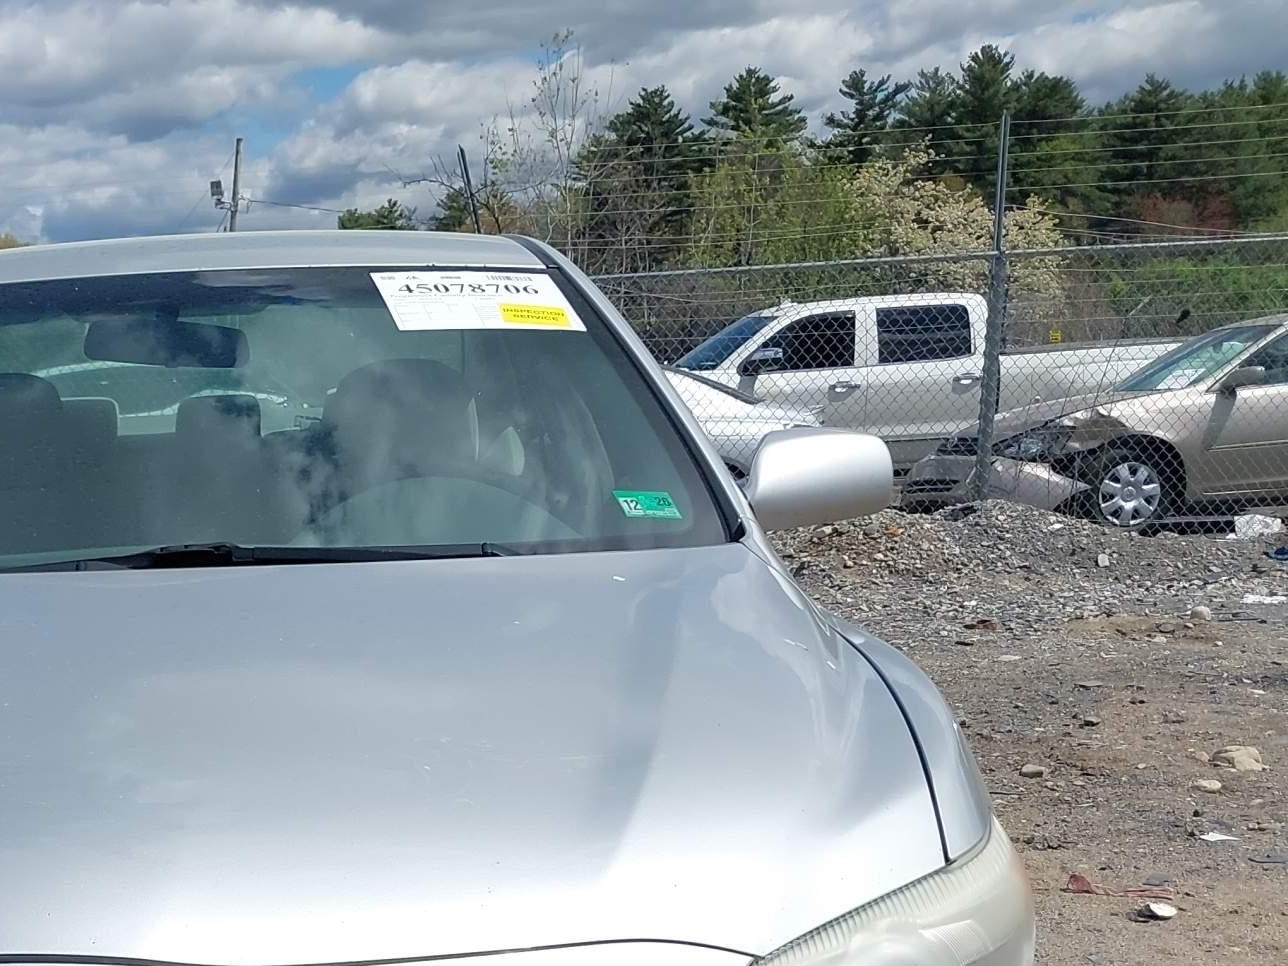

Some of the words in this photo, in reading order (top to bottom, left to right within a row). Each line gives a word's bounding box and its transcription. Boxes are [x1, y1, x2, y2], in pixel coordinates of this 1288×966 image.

[398, 283, 539, 294] 45078706
[502, 307, 565, 317] INSPECTION
[512, 313, 559, 321] SERVICE
[623, 499, 643, 511] 12
